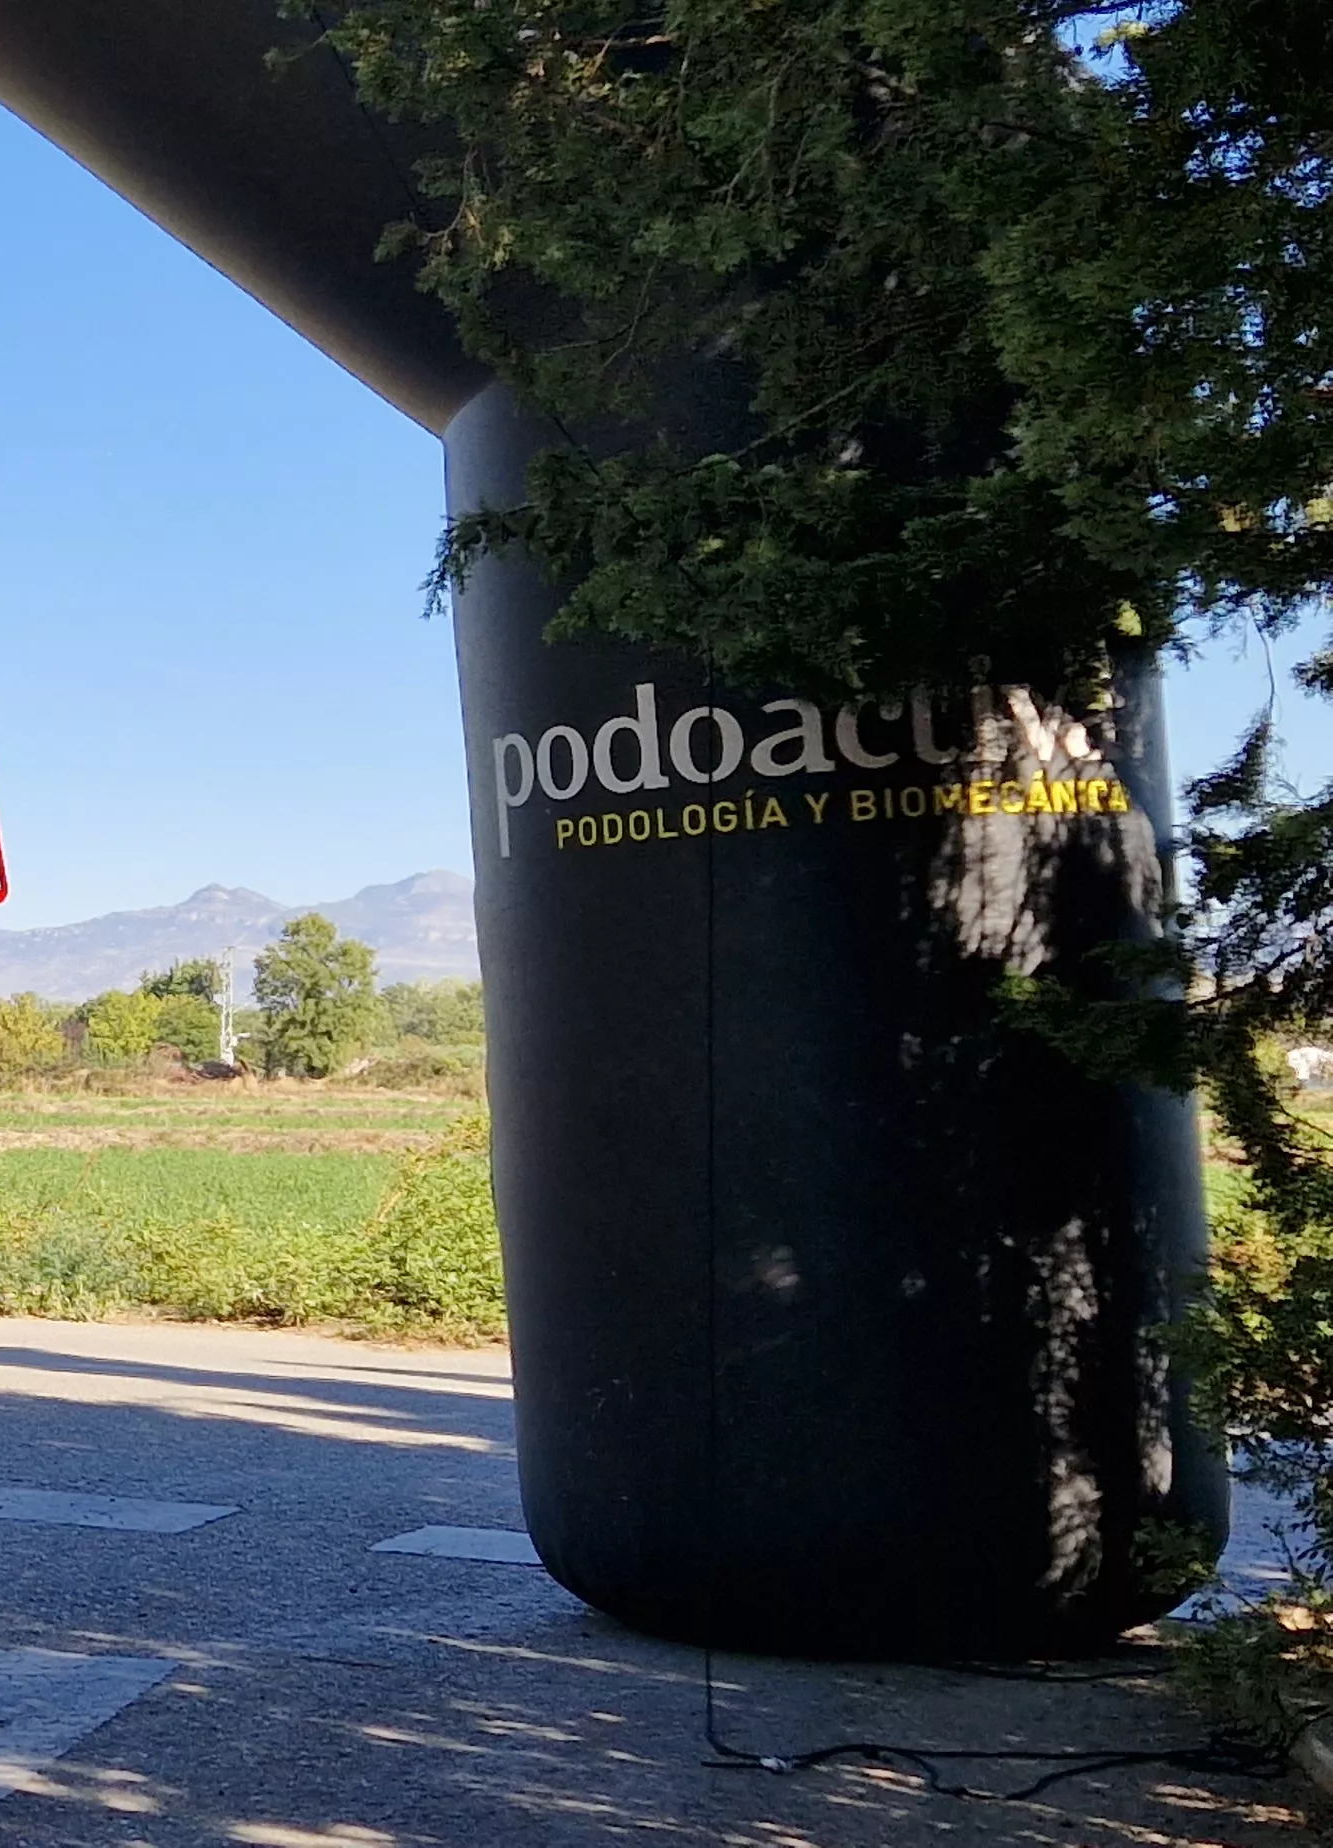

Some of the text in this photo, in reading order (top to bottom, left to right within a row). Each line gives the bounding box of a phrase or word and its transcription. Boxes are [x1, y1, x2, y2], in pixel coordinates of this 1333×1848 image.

[556, 769, 1131, 850] PODOLOGÍA Y BIOMECÁNICA
